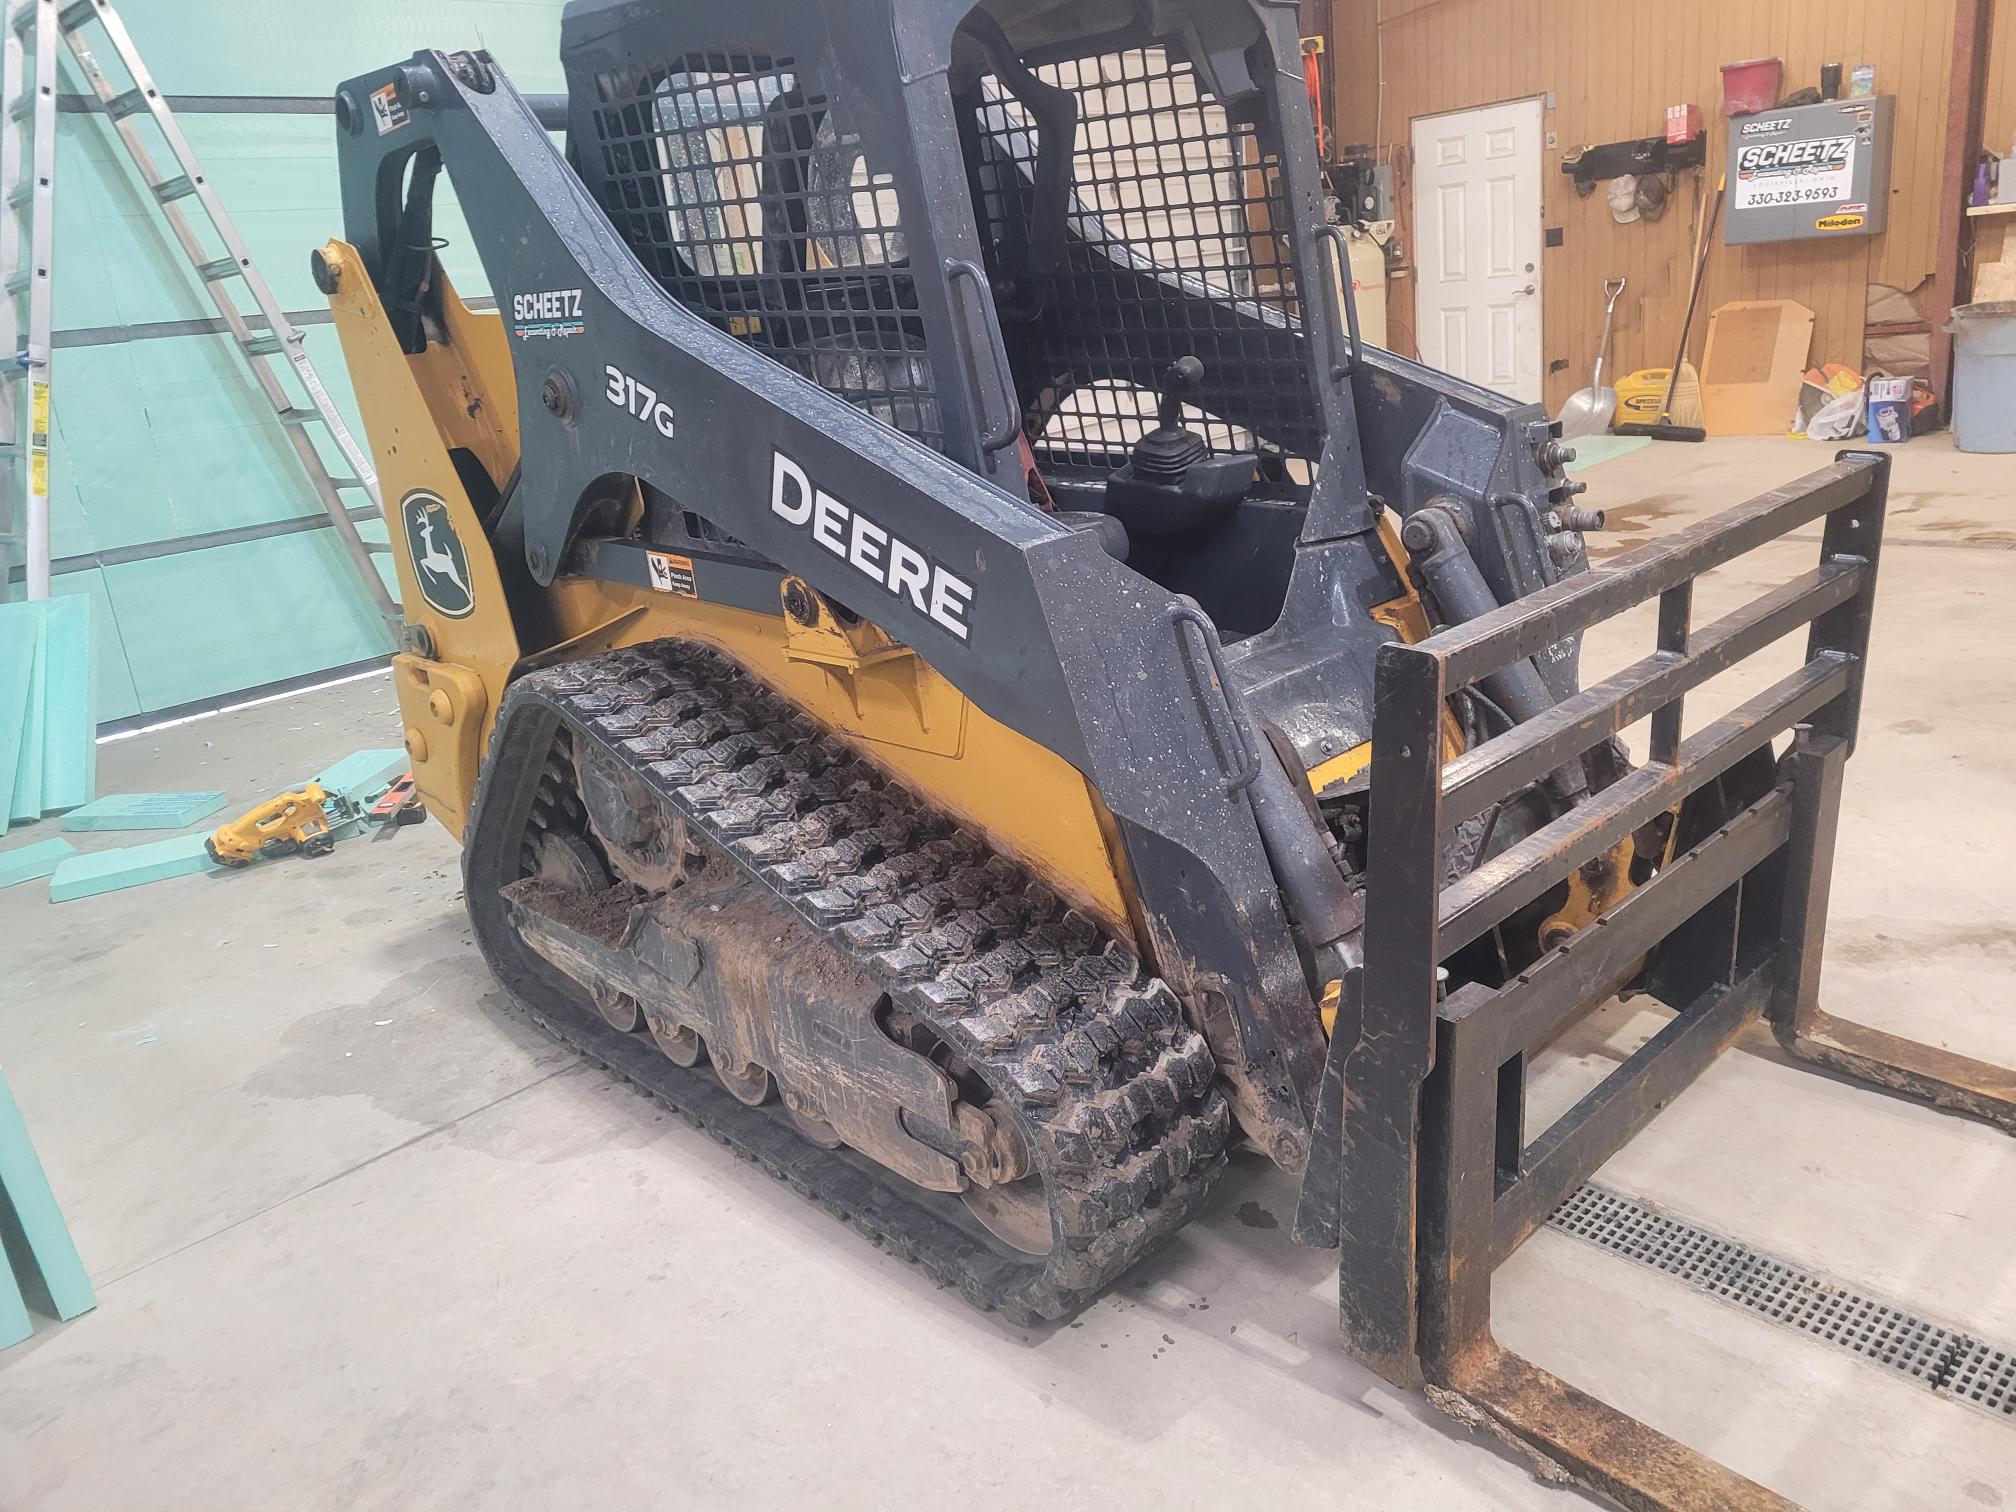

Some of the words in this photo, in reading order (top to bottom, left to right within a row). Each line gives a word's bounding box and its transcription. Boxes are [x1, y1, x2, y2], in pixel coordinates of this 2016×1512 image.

[1741, 118, 1793, 134] SCHEETZ
[1741, 137, 1855, 169] SCHEETZ
[1748, 187, 1838, 205] 330-323-9593
[1818, 218, 1861, 228] Milodon
[513, 289, 583, 321] SCHEETZ
[605, 364, 674, 439] 317G
[771, 450, 973, 640] DEERE
